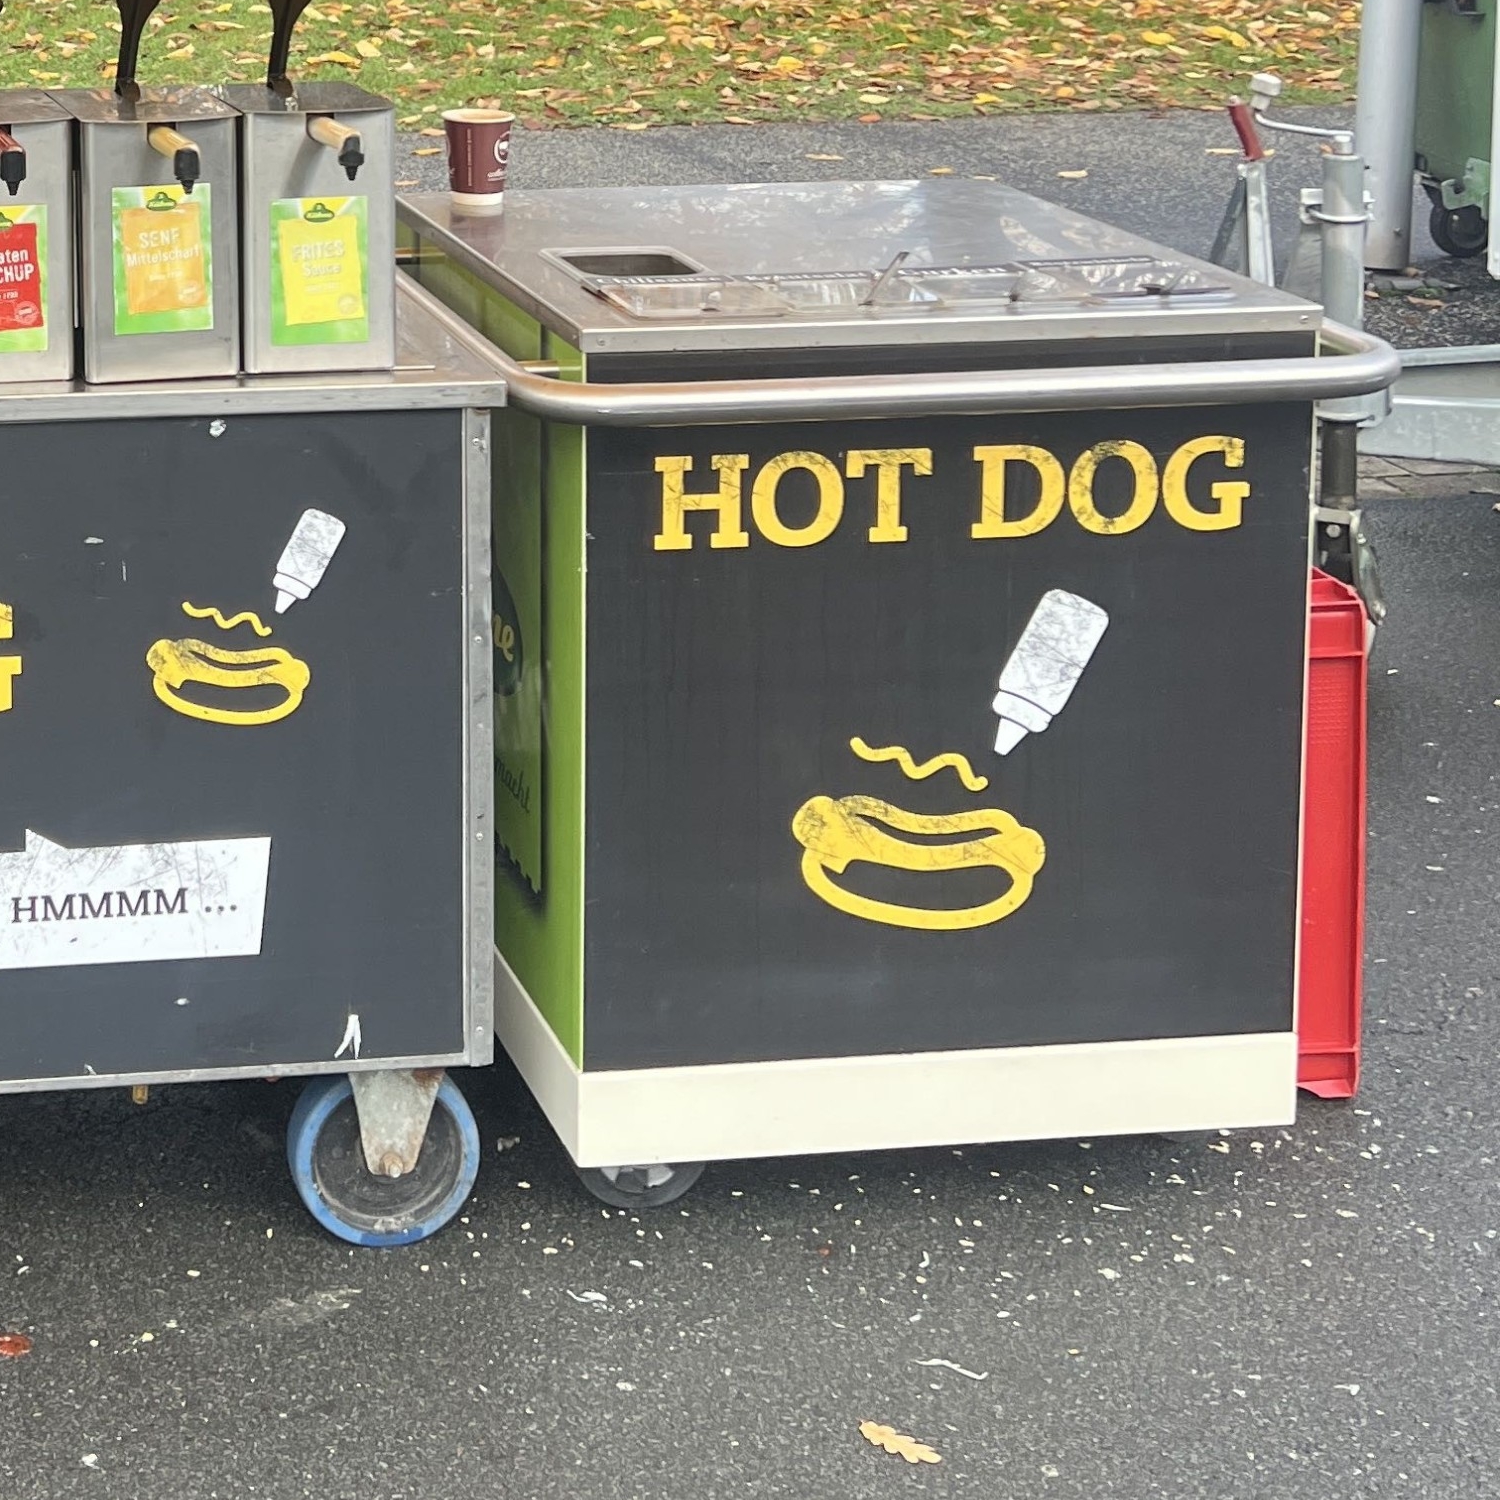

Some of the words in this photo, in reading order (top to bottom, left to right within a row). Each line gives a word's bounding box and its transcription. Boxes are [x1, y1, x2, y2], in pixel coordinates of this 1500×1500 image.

[138, 227, 180, 249] SENF
[653, 447, 934, 551] HOT
[971, 435, 1251, 540] DOG
[11, 887, 189, 924] HMMMM
